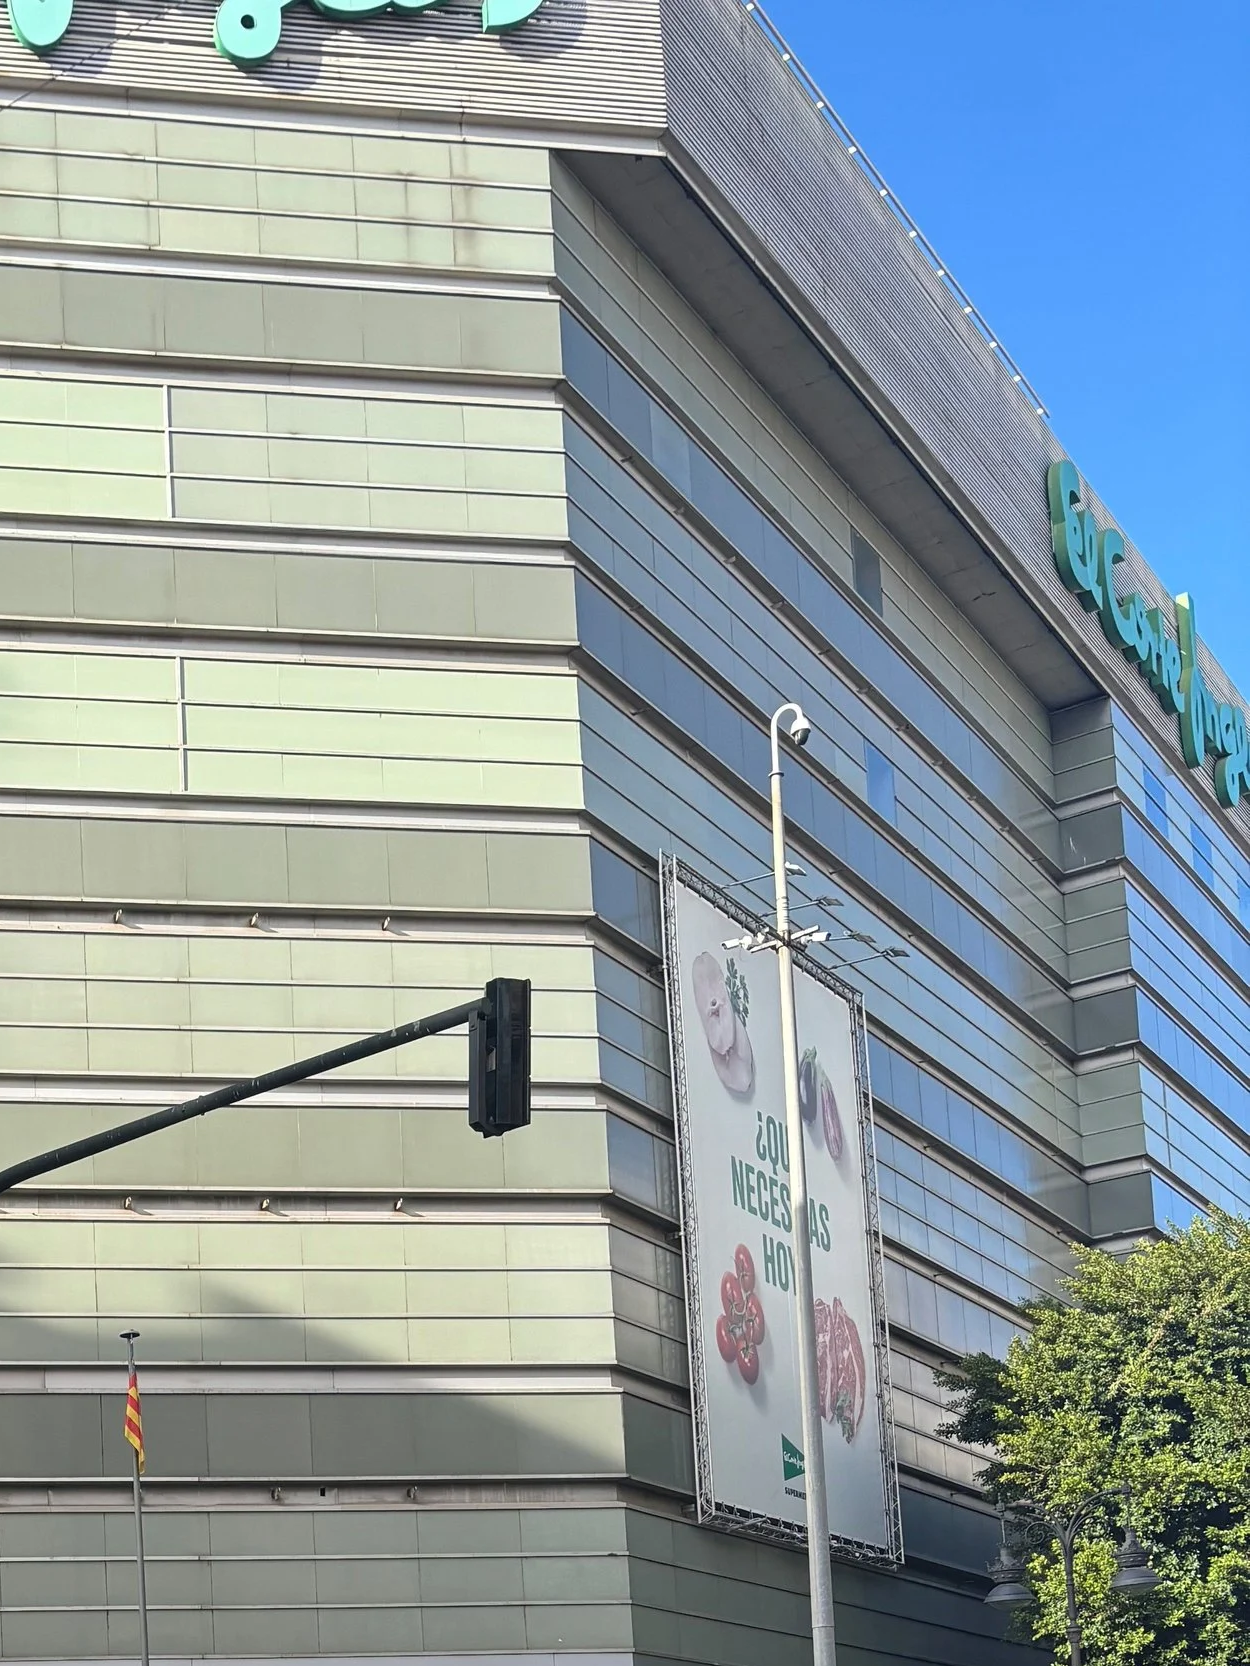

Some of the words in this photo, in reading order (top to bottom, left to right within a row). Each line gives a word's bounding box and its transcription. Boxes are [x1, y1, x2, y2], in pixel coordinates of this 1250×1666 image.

[1176, 591, 1250, 809] Ingl
[756, 1110, 791, 1176] ¿QU
[731, 1155, 831, 1252] NECESAS
